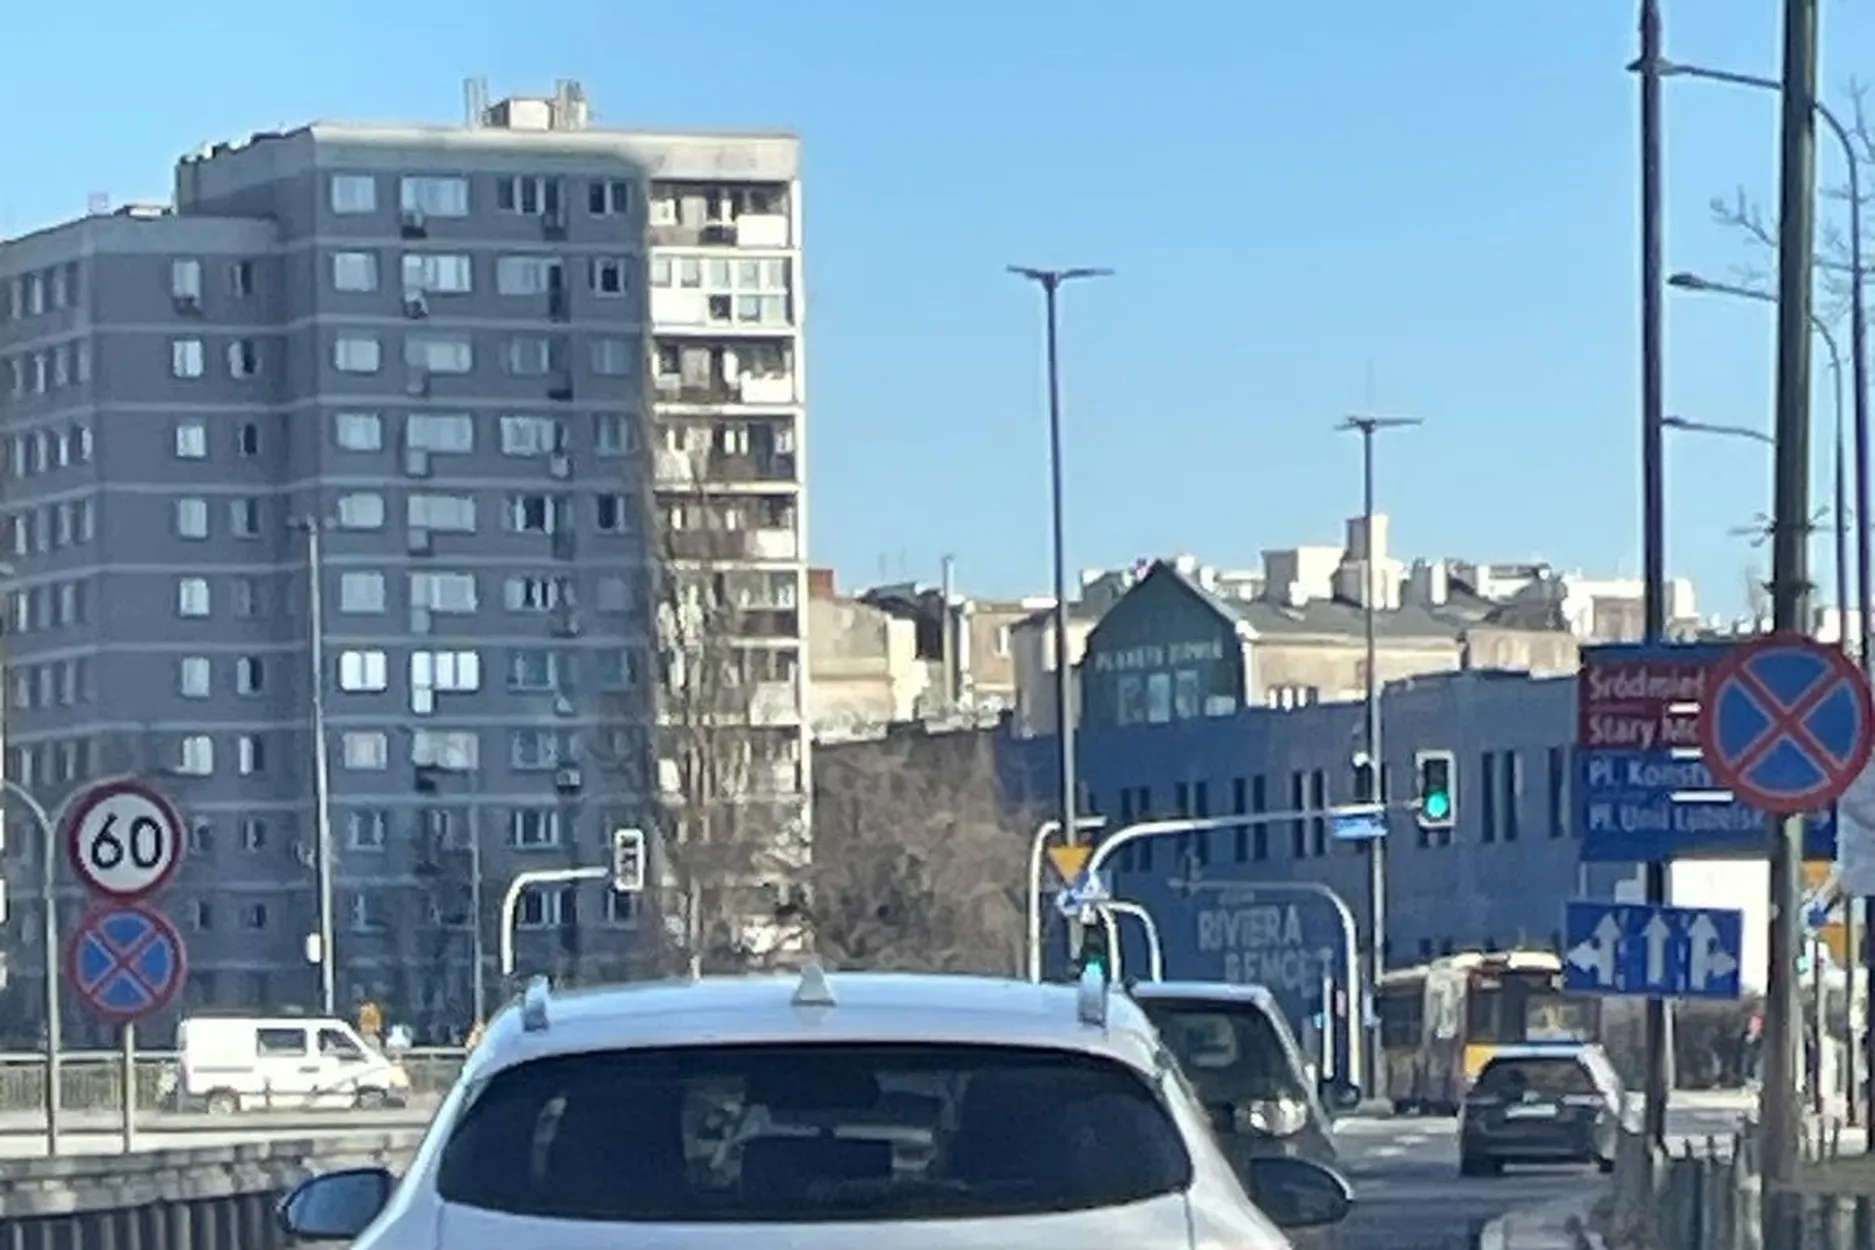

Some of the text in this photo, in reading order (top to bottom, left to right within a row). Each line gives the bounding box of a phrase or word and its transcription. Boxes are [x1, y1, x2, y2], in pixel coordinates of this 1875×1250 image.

[1588, 714, 1656, 749] Stary
[91, 813, 164, 869] 60
[1198, 904, 1303, 951] RIVIERA
